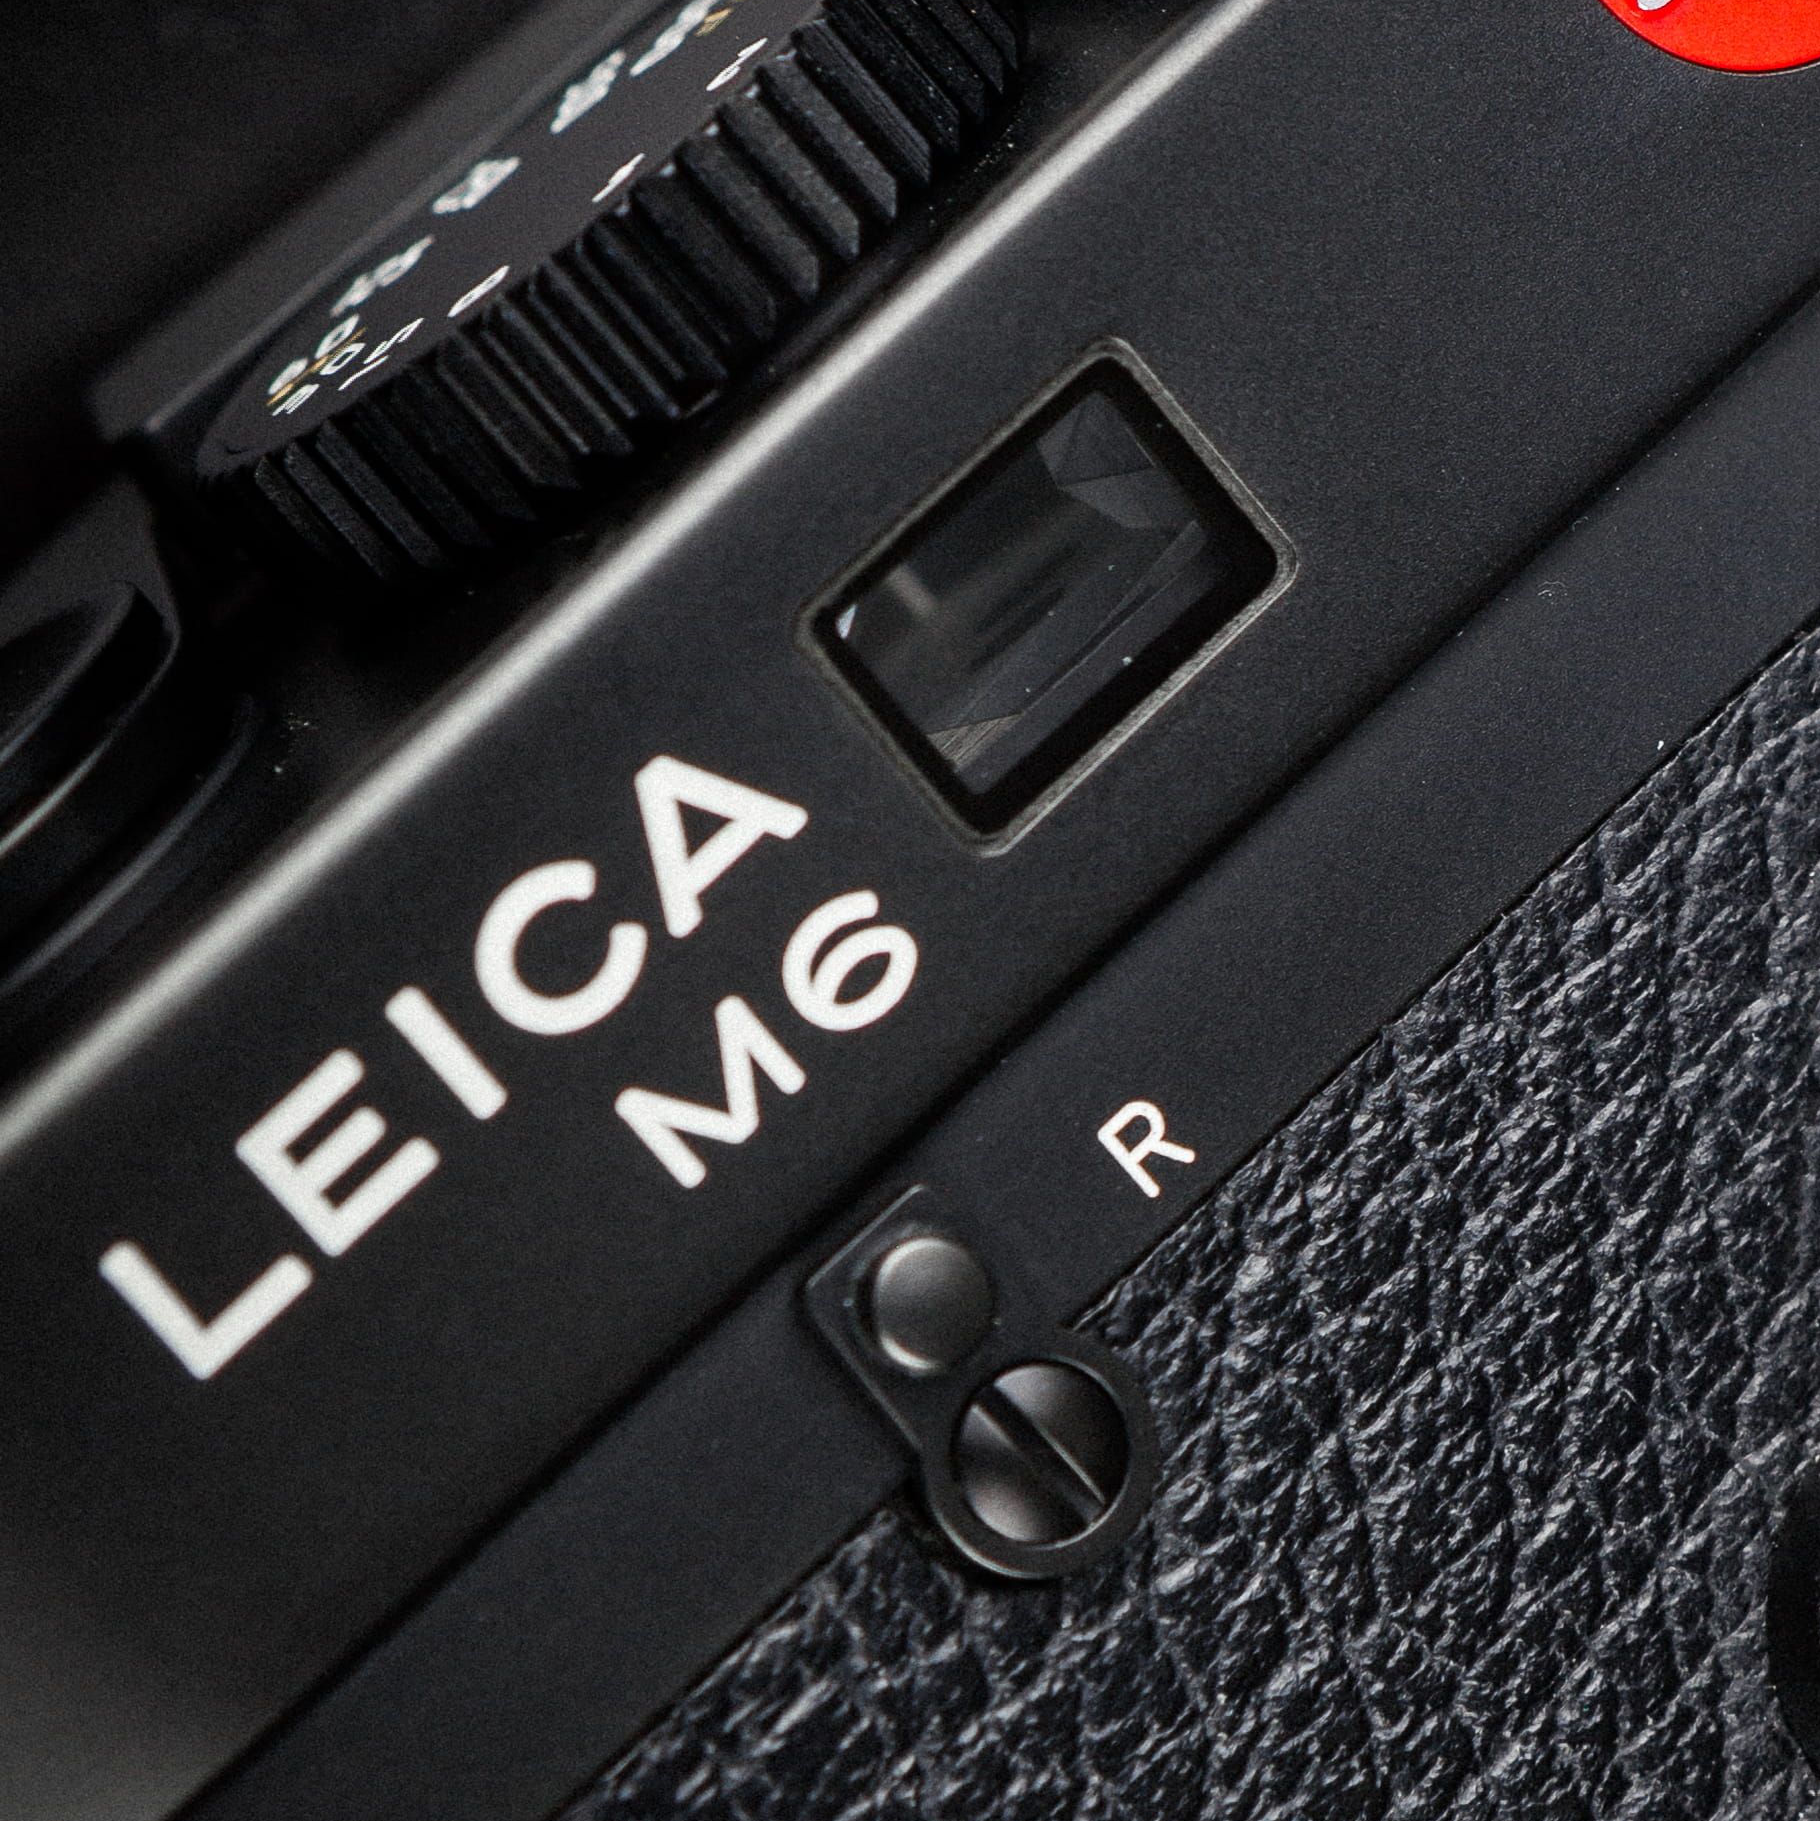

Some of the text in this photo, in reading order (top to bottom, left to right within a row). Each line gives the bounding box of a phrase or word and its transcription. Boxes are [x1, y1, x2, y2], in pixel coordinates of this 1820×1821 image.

[97, 754, 809, 1381] LEICA
[614, 888, 920, 1189] M6
[1096, 1098, 1196, 1199] R
